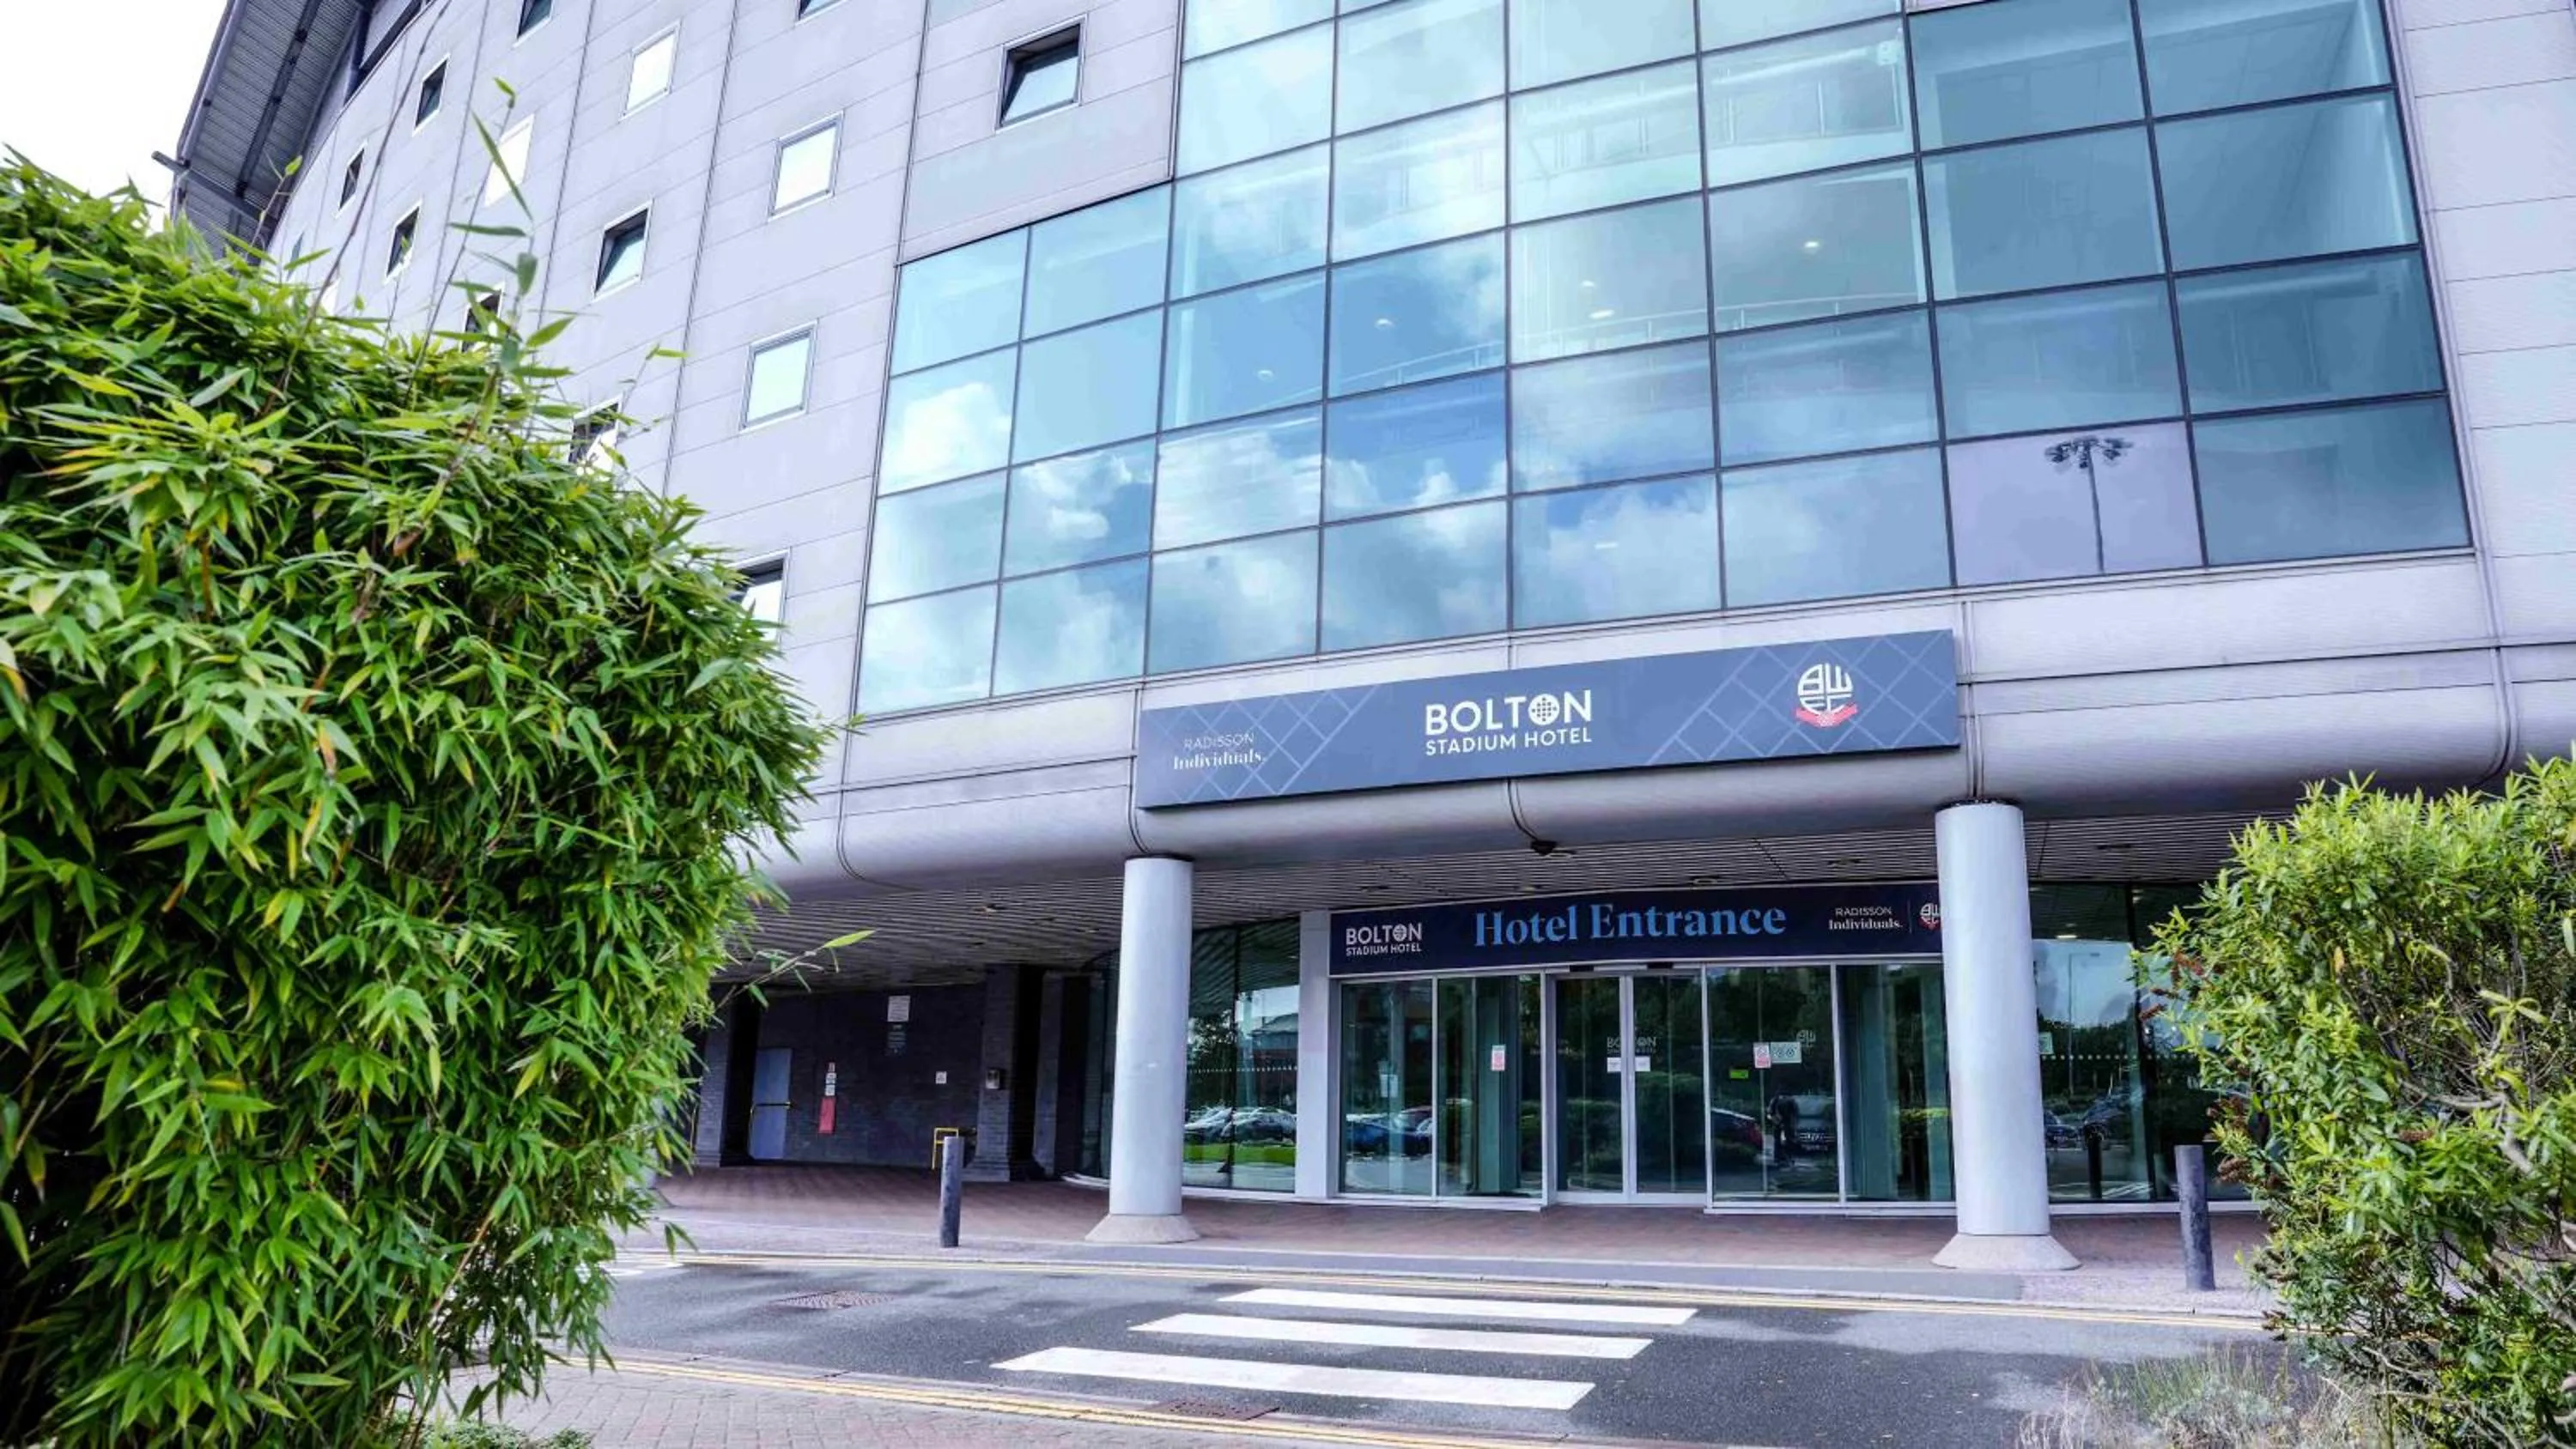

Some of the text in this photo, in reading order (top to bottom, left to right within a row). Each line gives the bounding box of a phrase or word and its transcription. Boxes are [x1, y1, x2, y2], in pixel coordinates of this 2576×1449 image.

[1425, 689, 1592, 736] BOLTON
[1183, 734, 1255, 749] RADISSON
[1425, 727, 1593, 755] STADIUM HOTEL
[1835, 906, 1892, 917] RADISSON
[1346, 923, 1423, 945] BOLTON
[1474, 903, 1787, 947] Hotel Entrance
[1346, 943, 1423, 956] STADIUM HOTEL
